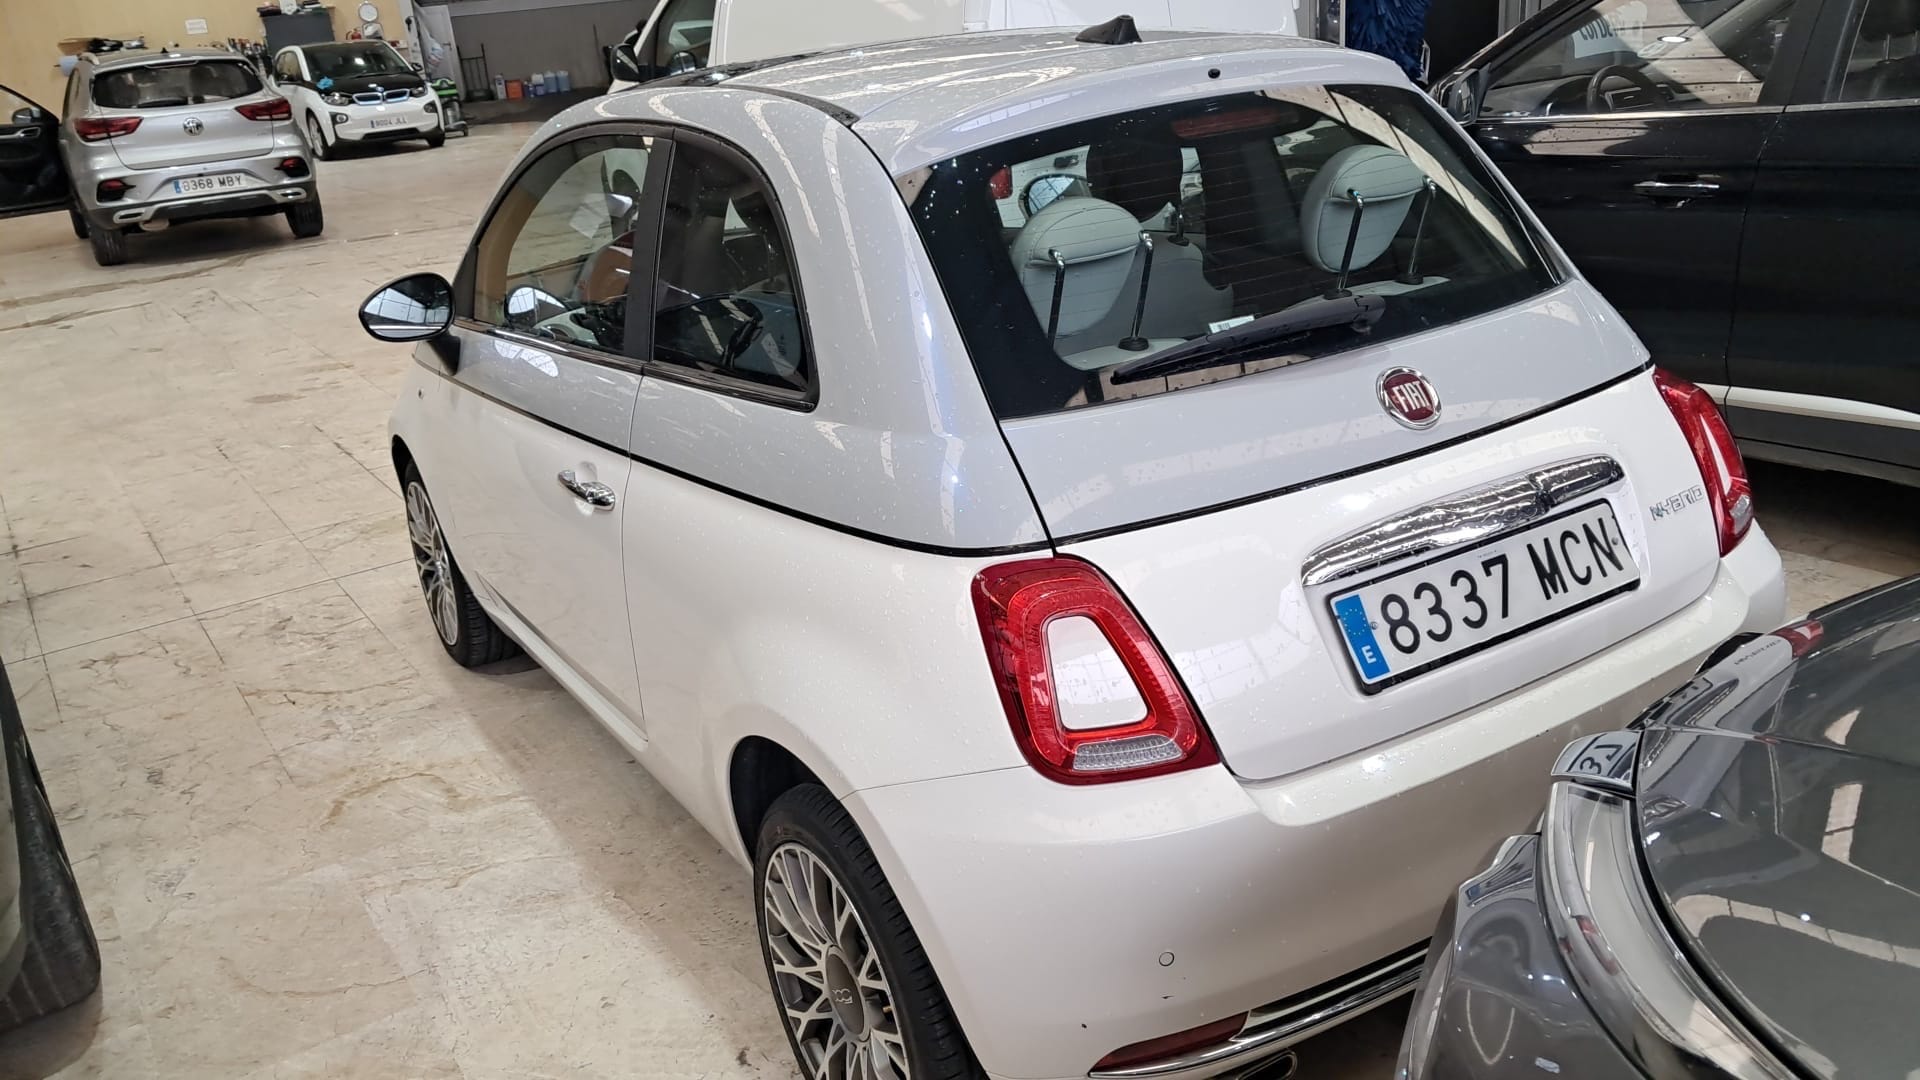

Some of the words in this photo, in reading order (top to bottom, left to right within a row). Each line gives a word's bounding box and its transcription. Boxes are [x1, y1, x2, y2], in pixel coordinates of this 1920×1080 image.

[182, 178, 214, 192] 8368
[218, 175, 242, 188] MBY
[1392, 380, 1430, 412] FIAT
[1361, 645, 1377, 664] E
[1380, 553, 1509, 654] 8337
[1526, 517, 1624, 600] MCN
